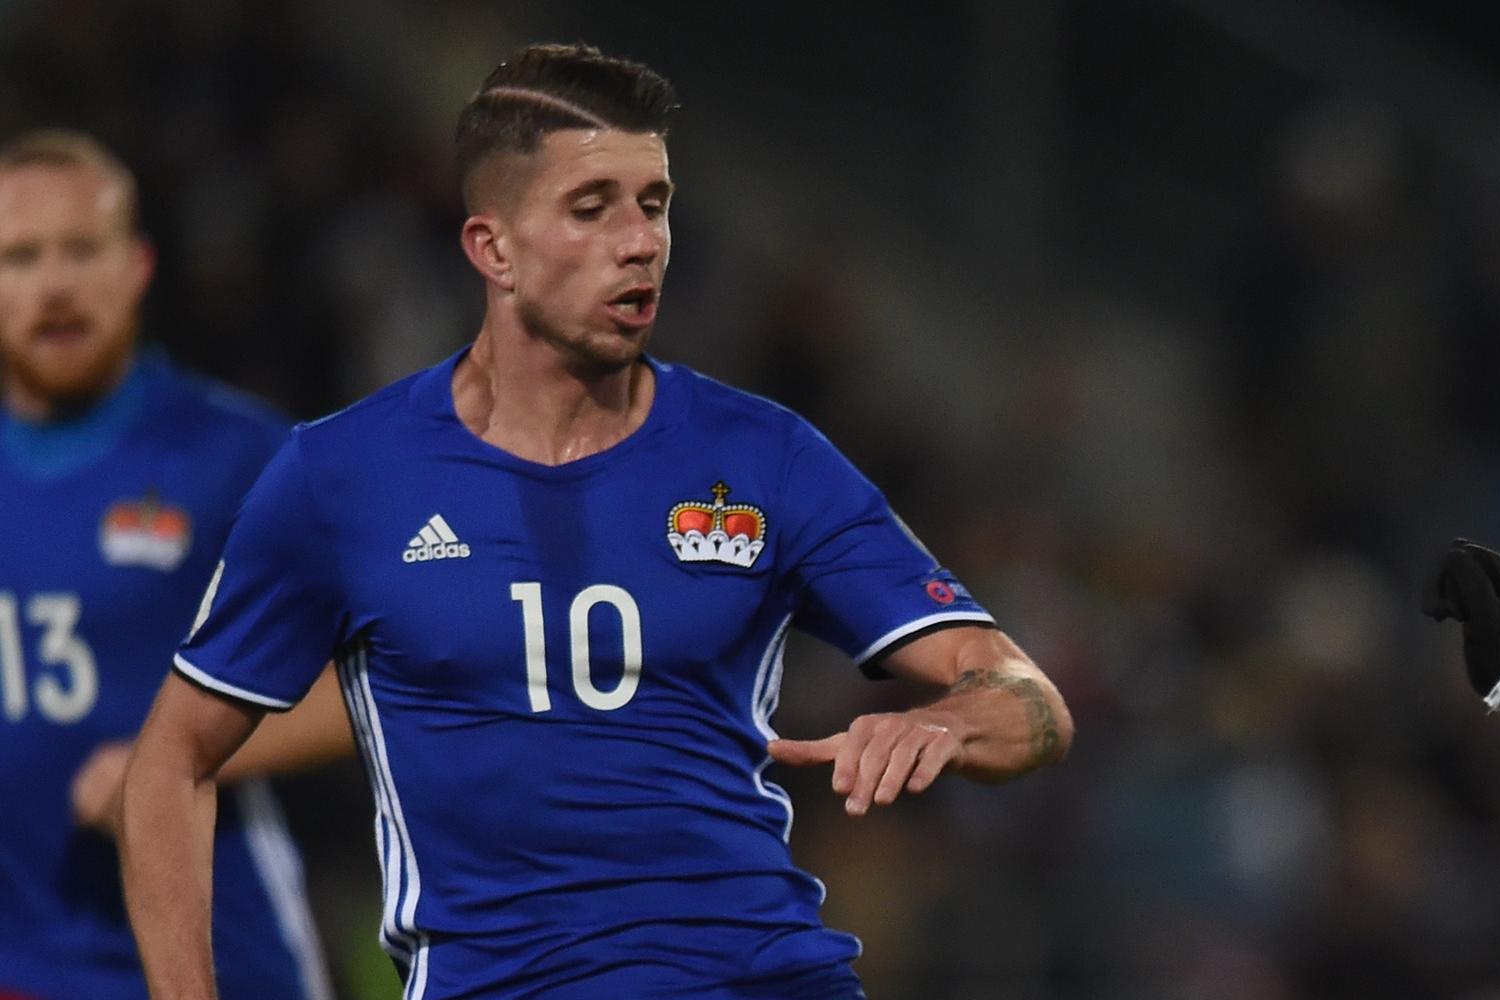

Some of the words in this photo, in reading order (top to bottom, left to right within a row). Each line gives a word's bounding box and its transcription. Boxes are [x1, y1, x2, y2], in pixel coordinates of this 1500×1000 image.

[402, 543, 471, 563] adidas
[0, 591, 98, 723] 13
[510, 582, 642, 712] 10
